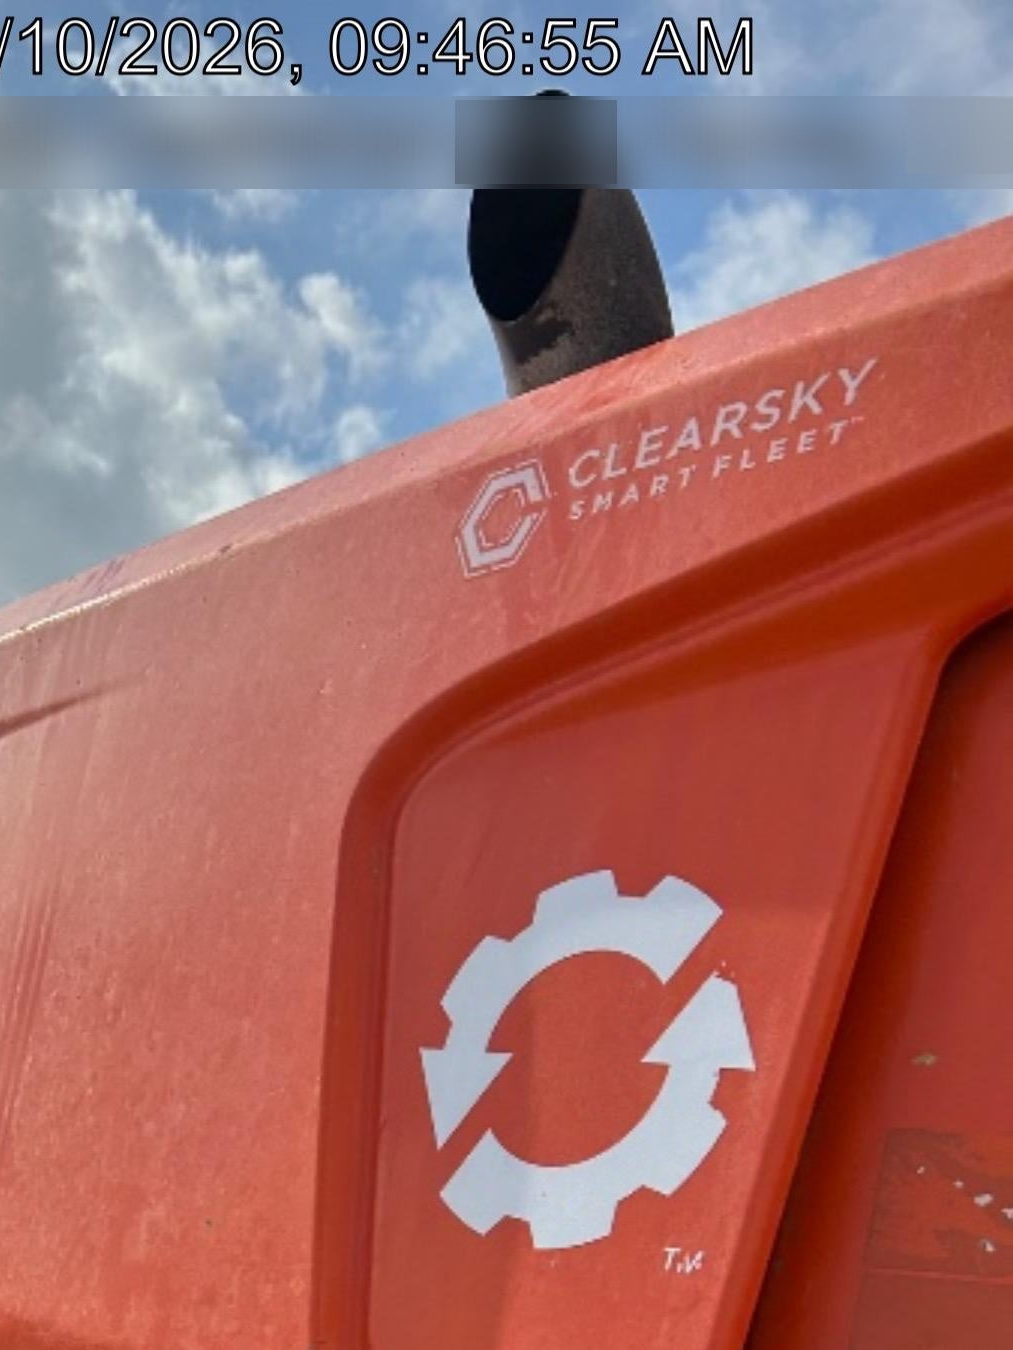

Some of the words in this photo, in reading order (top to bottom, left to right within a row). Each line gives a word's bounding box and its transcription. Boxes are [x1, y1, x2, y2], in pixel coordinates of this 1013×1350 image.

[568, 358, 878, 489] CLEARSKY
[568, 464, 697, 521] SMART
[712, 420, 849, 479] FLEET
